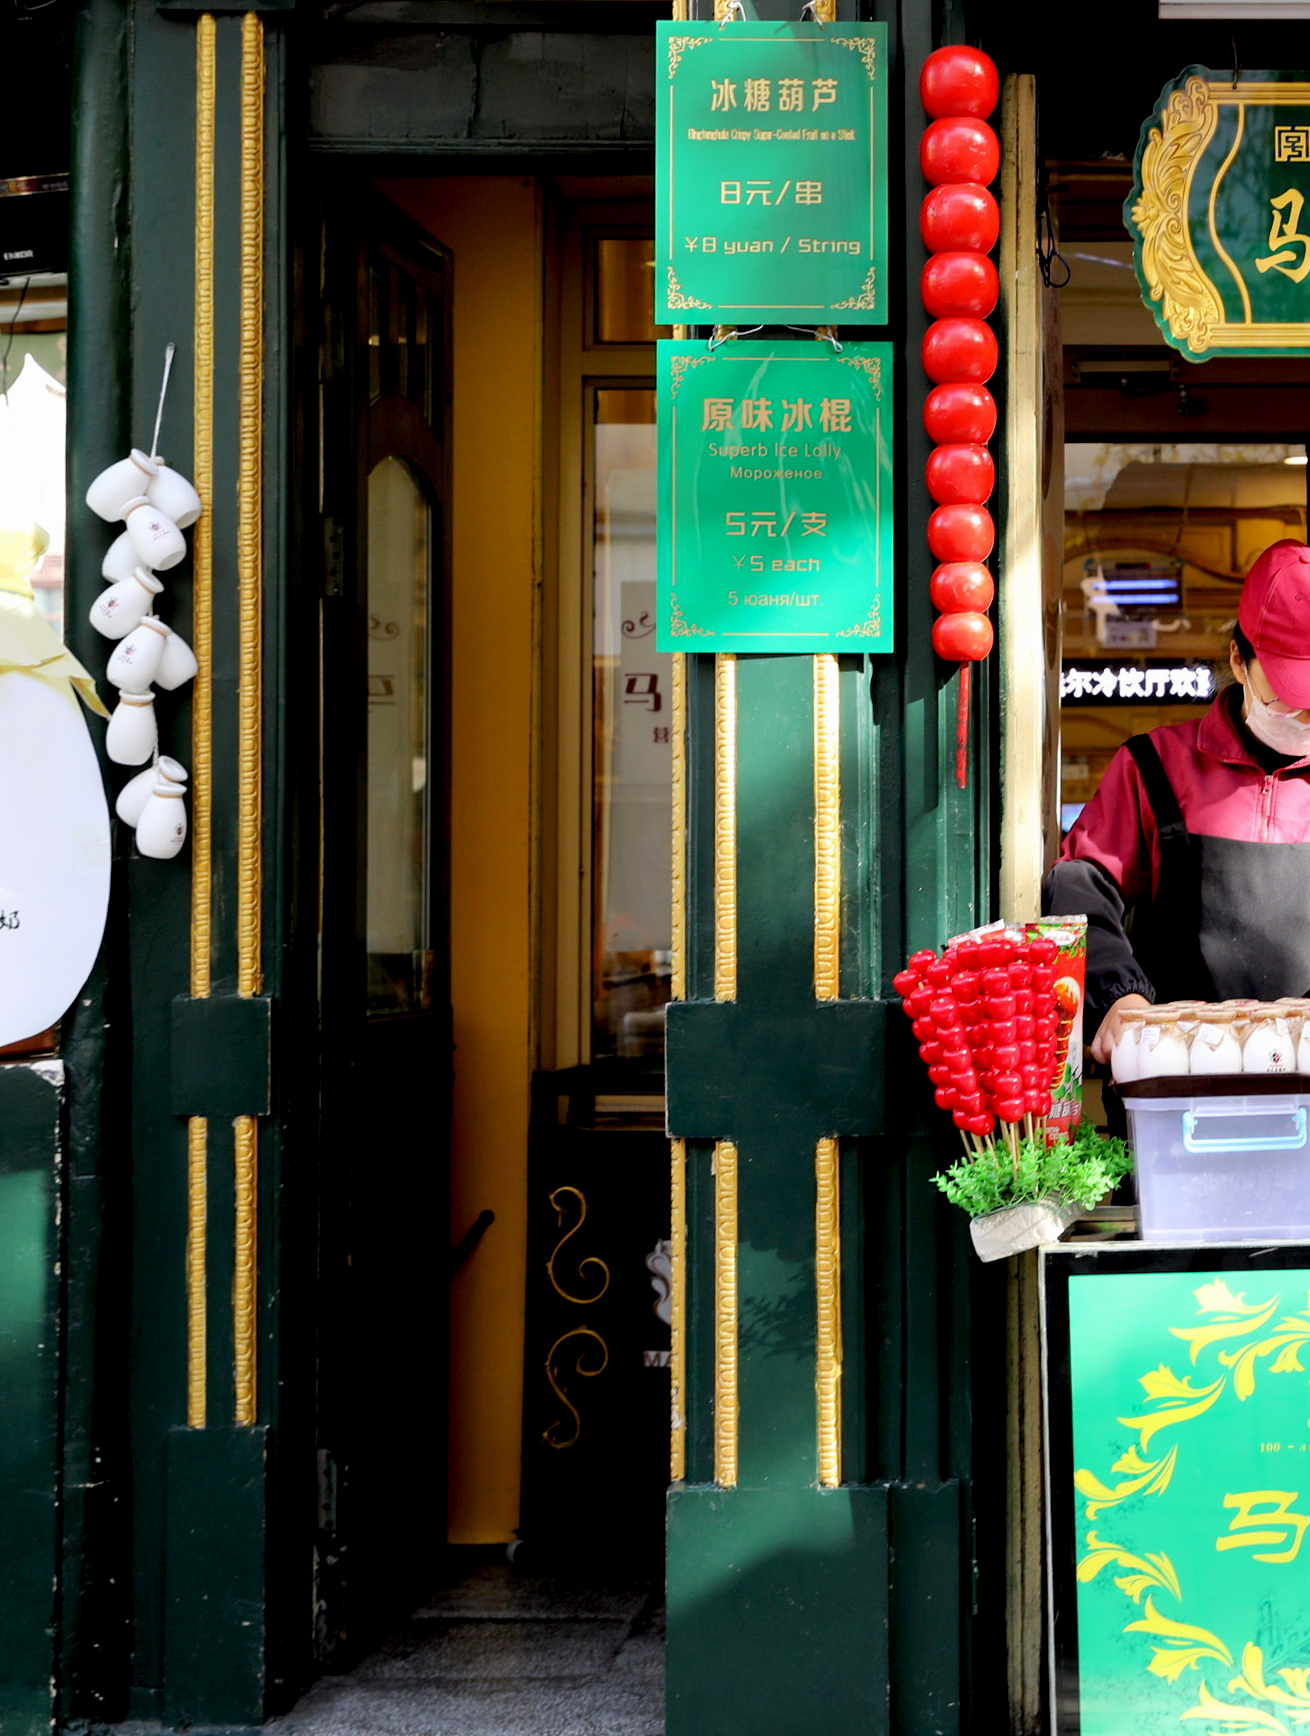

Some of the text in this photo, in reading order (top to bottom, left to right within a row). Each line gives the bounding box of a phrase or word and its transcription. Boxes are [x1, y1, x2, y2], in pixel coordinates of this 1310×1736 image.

[711, 78, 838, 112] 冰糖葫芦
[724, 239, 774, 255] yuan
[798, 237, 861, 255] String
[702, 397, 852, 433] 原味冰棍
[708, 443, 842, 460] Superb Ice Lolly
[730, 466, 823, 480] Мороженое
[725, 511, 827, 537] 5元/支
[772, 555, 820, 572] each
[728, 591, 824, 607] 5 юаня/шт.
[1061, 668, 1212, 698] 尔冷饮厅欢
[624, 674, 661, 711] 马
[1260, 1442, 1281, 1453] 100
